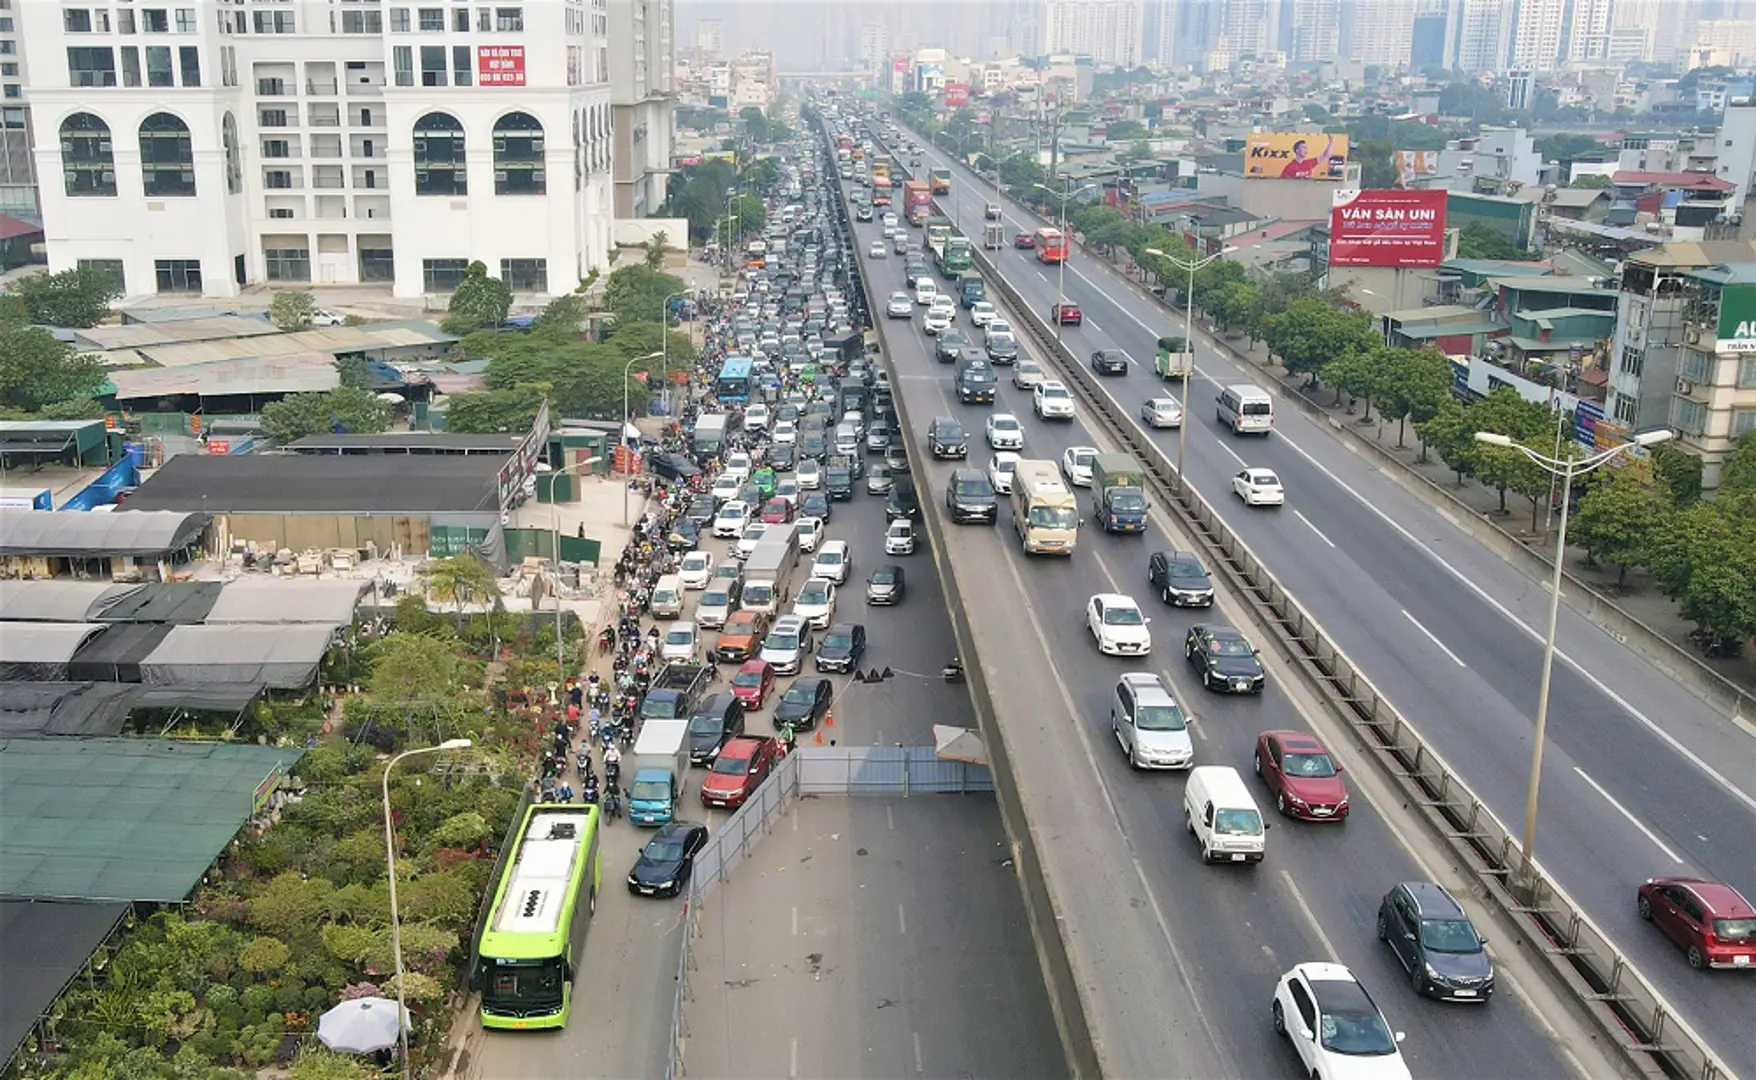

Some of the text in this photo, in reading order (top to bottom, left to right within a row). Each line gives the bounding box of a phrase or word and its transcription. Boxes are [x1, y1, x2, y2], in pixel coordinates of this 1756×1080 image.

[1251, 147, 1290, 159] Kixx
[1341, 207, 1371, 219] VÁN
[1409, 209, 1436, 220] UNI
